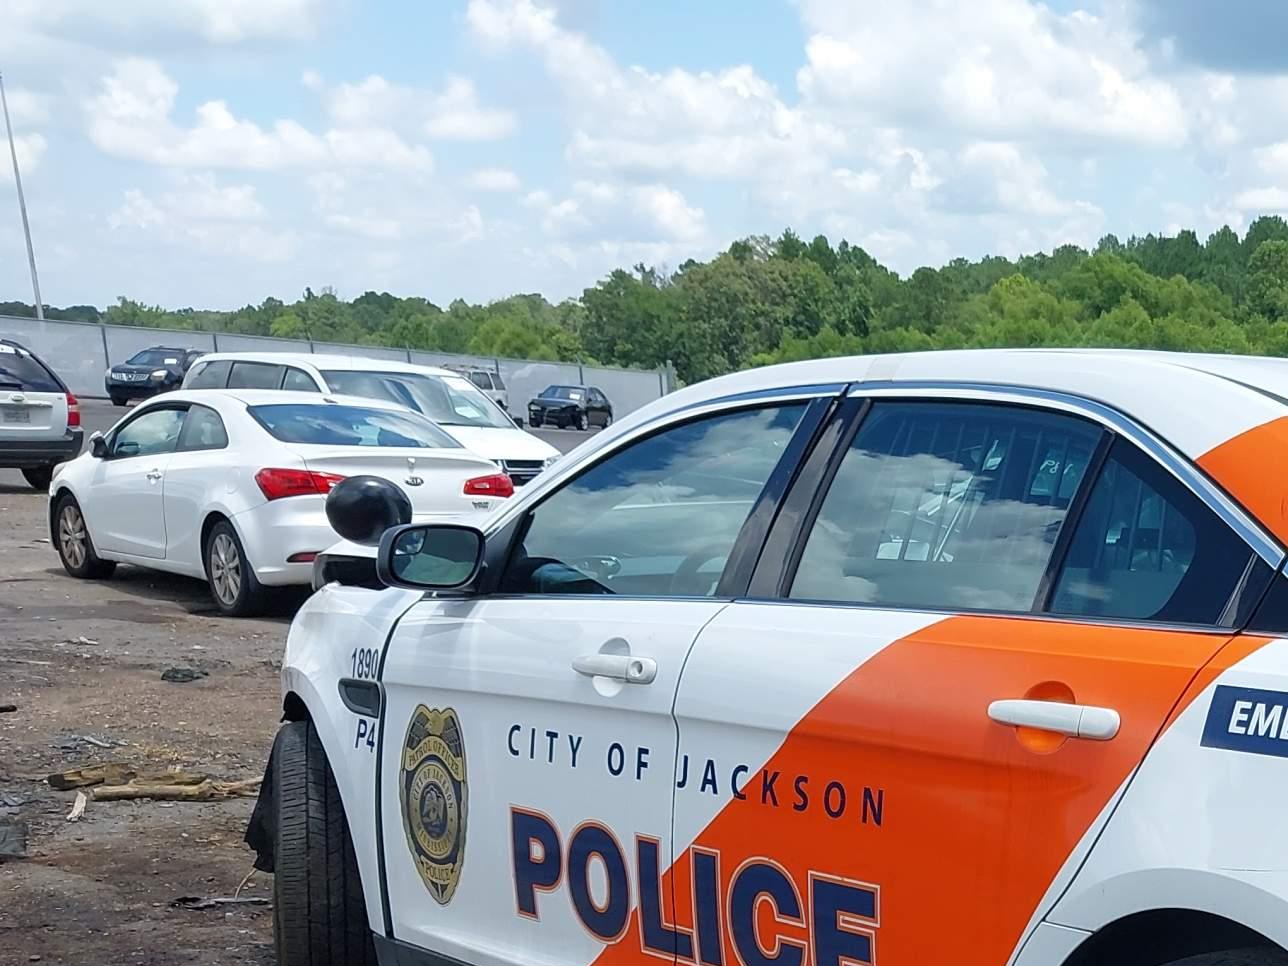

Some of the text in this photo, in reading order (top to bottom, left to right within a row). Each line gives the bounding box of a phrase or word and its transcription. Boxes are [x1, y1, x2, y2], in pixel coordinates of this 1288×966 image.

[352, 648, 379, 679] 1890
[355, 718, 375, 753] P4
[508, 724, 885, 826] CITY OF JACKSON
